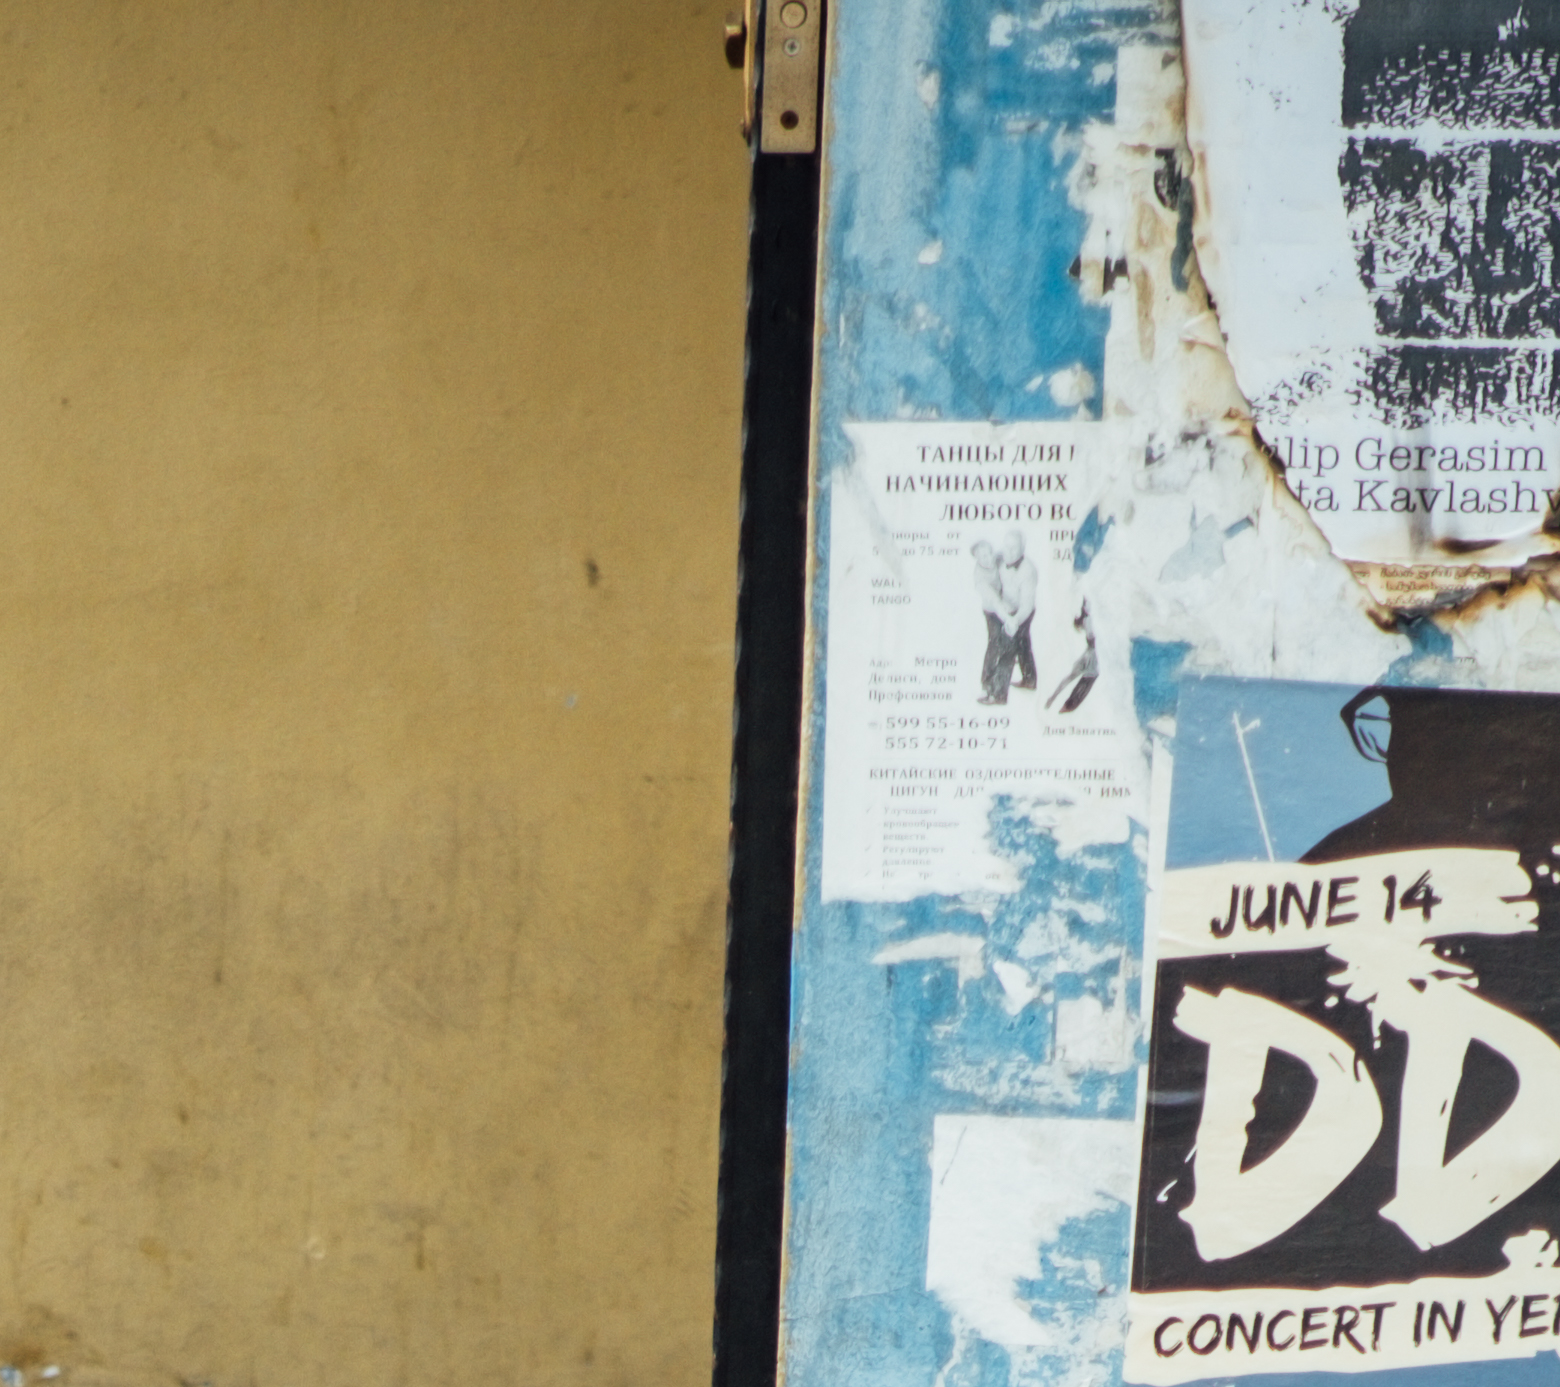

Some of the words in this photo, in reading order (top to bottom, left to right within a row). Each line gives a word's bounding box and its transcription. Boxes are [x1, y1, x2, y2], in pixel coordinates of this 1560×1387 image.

[917, 444, 1005, 465] ТАНЦЫ
[1011, 444, 1061, 467] ДЛЯ
[1354, 437, 1548, 474] Gerasim
[886, 473, 1069, 495] НАЧИНАЮЩИХ
[939, 502, 1042, 521] ЛЮБОГО
[919, 545, 934, 556] 75
[871, 595, 911, 605] TANGO
[914, 656, 958, 669] Метро
[930, 674, 957, 685] дом
[868, 690, 953, 704] Профсоюзов
[886, 716, 920, 729] 599
[926, 716, 1011, 729] 55-16-09
[885, 737, 920, 750] 555
[925, 737, 1008, 750] 72-10-71
[869, 766, 957, 780] КИТАЙСКИЕ
[890, 785, 939, 799] ЦИГУН
[1210, 875, 1361, 938] JUNE
[1382, 870, 1443, 923] 14
[1153, 1301, 1397, 1358] CONCERT
[1412, 1299, 1466, 1346] IN
